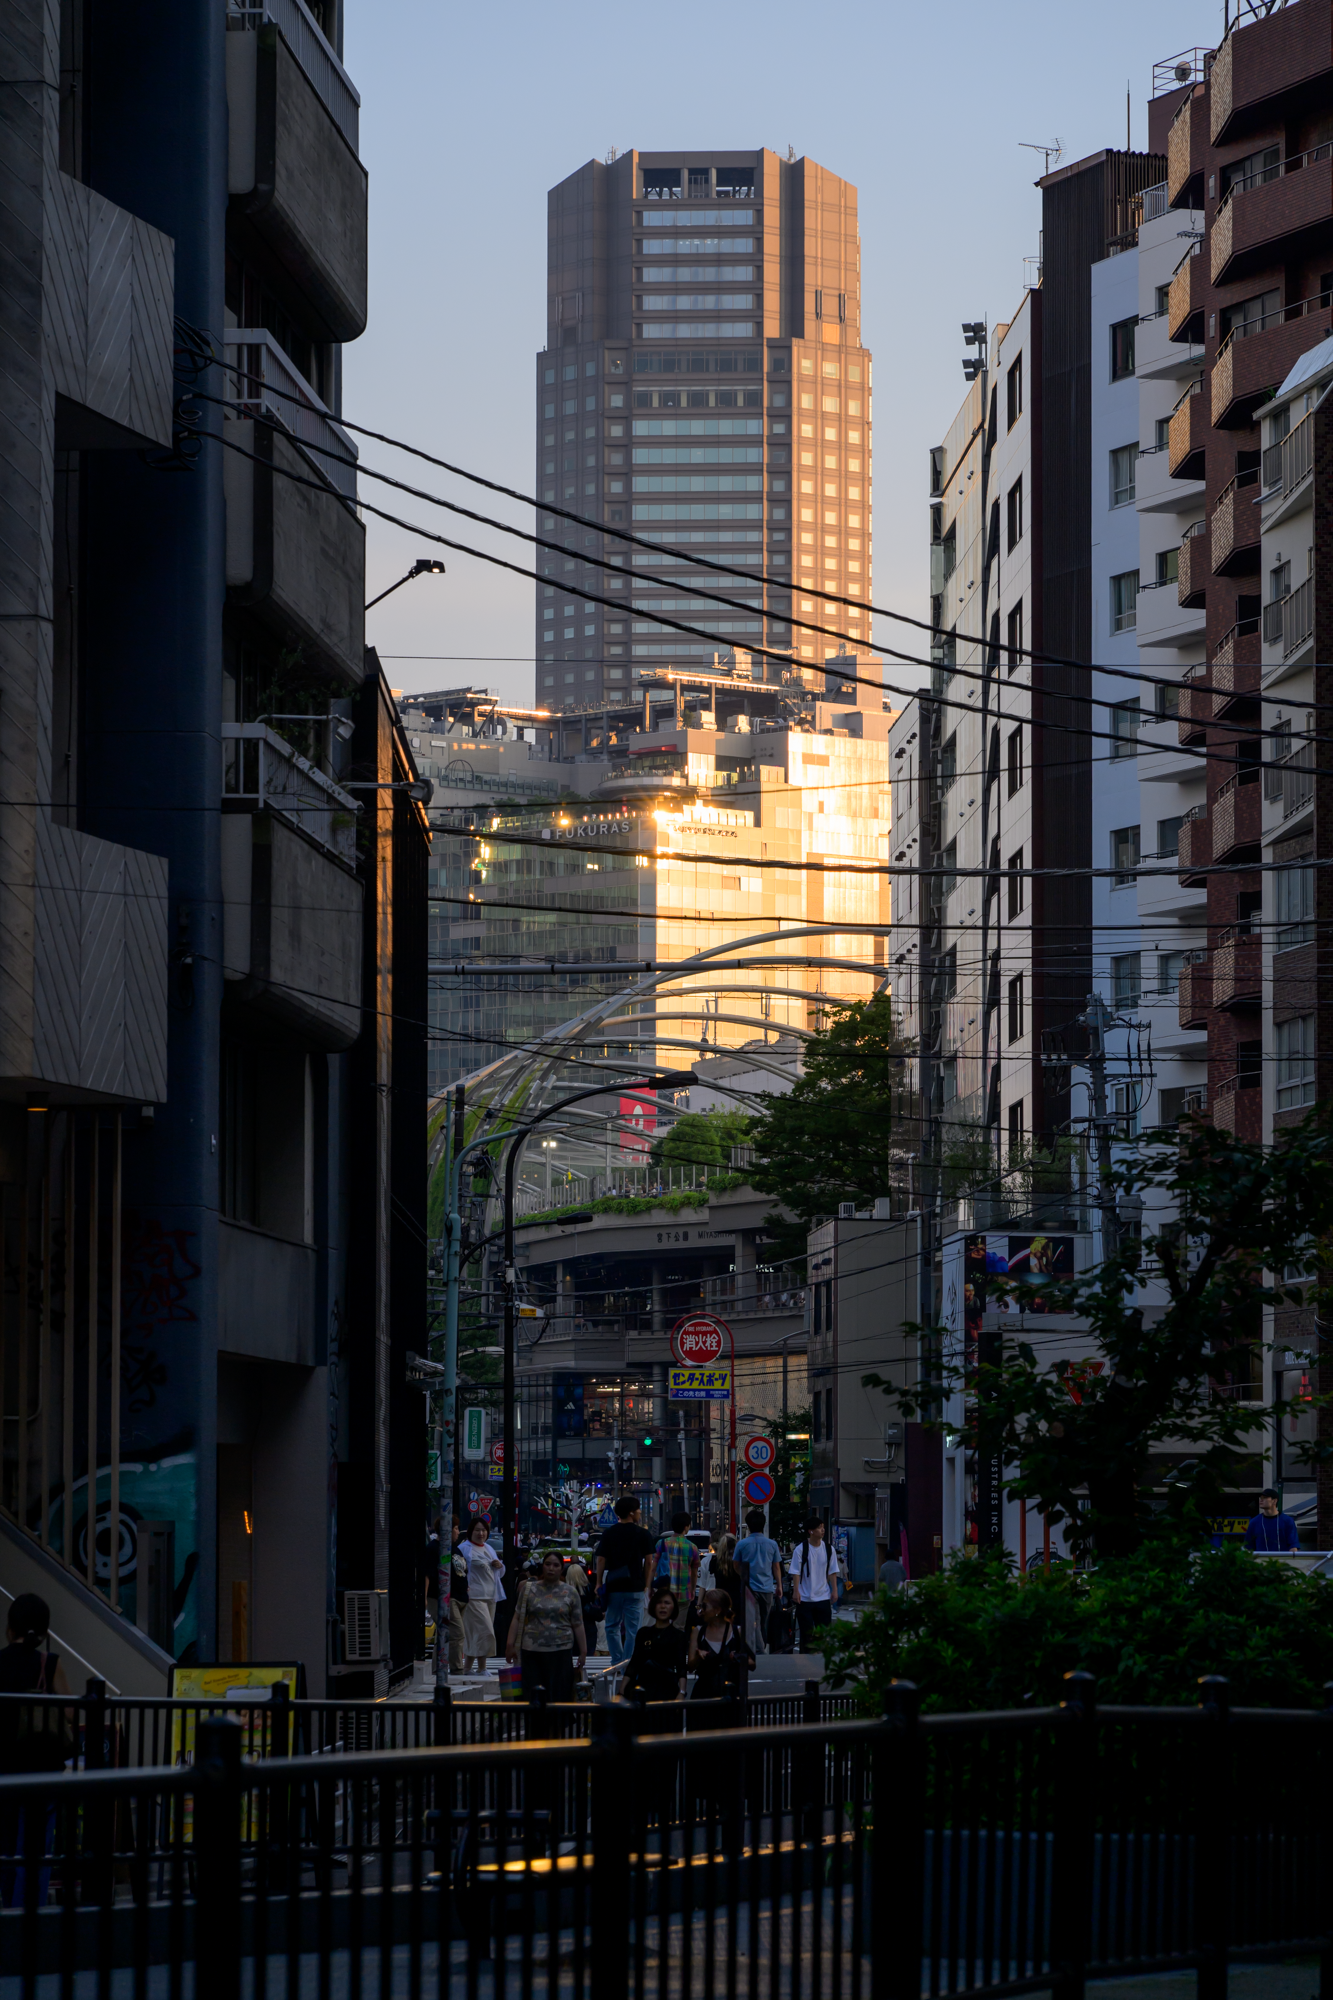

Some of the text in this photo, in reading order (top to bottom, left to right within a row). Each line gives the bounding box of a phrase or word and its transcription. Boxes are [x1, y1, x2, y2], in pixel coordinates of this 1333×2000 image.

[556, 821, 630, 840] FUKURAS
[657, 1231, 689, 1244] 宮下公園
[682, 1333, 719, 1351] 消火栓
[672, 1372, 728, 1387] センタースポーツ
[751, 1445, 769, 1460] 30
